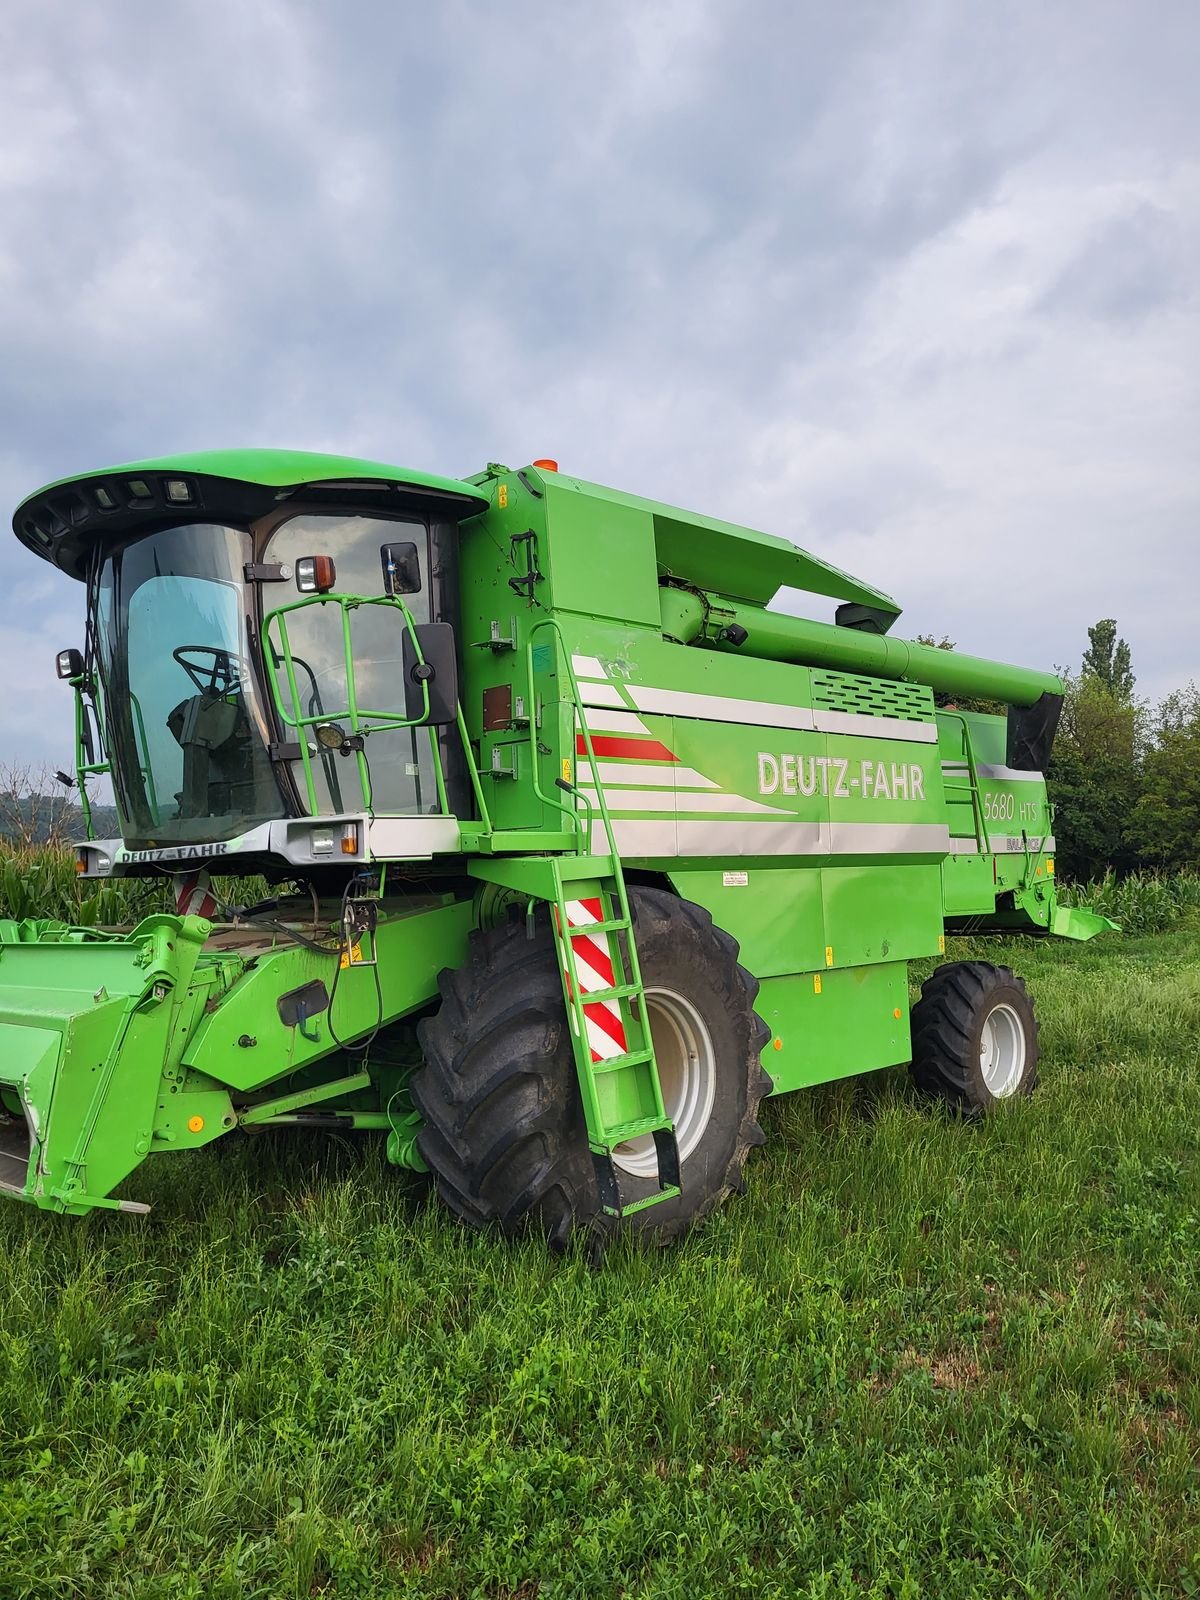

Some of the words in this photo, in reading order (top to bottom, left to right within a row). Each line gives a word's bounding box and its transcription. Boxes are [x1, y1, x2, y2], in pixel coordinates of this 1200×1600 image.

[757, 752, 926, 801] DEUTZ-FAHR
[984, 794, 1014, 820] 5680
[1019, 802, 1037, 821] HTS
